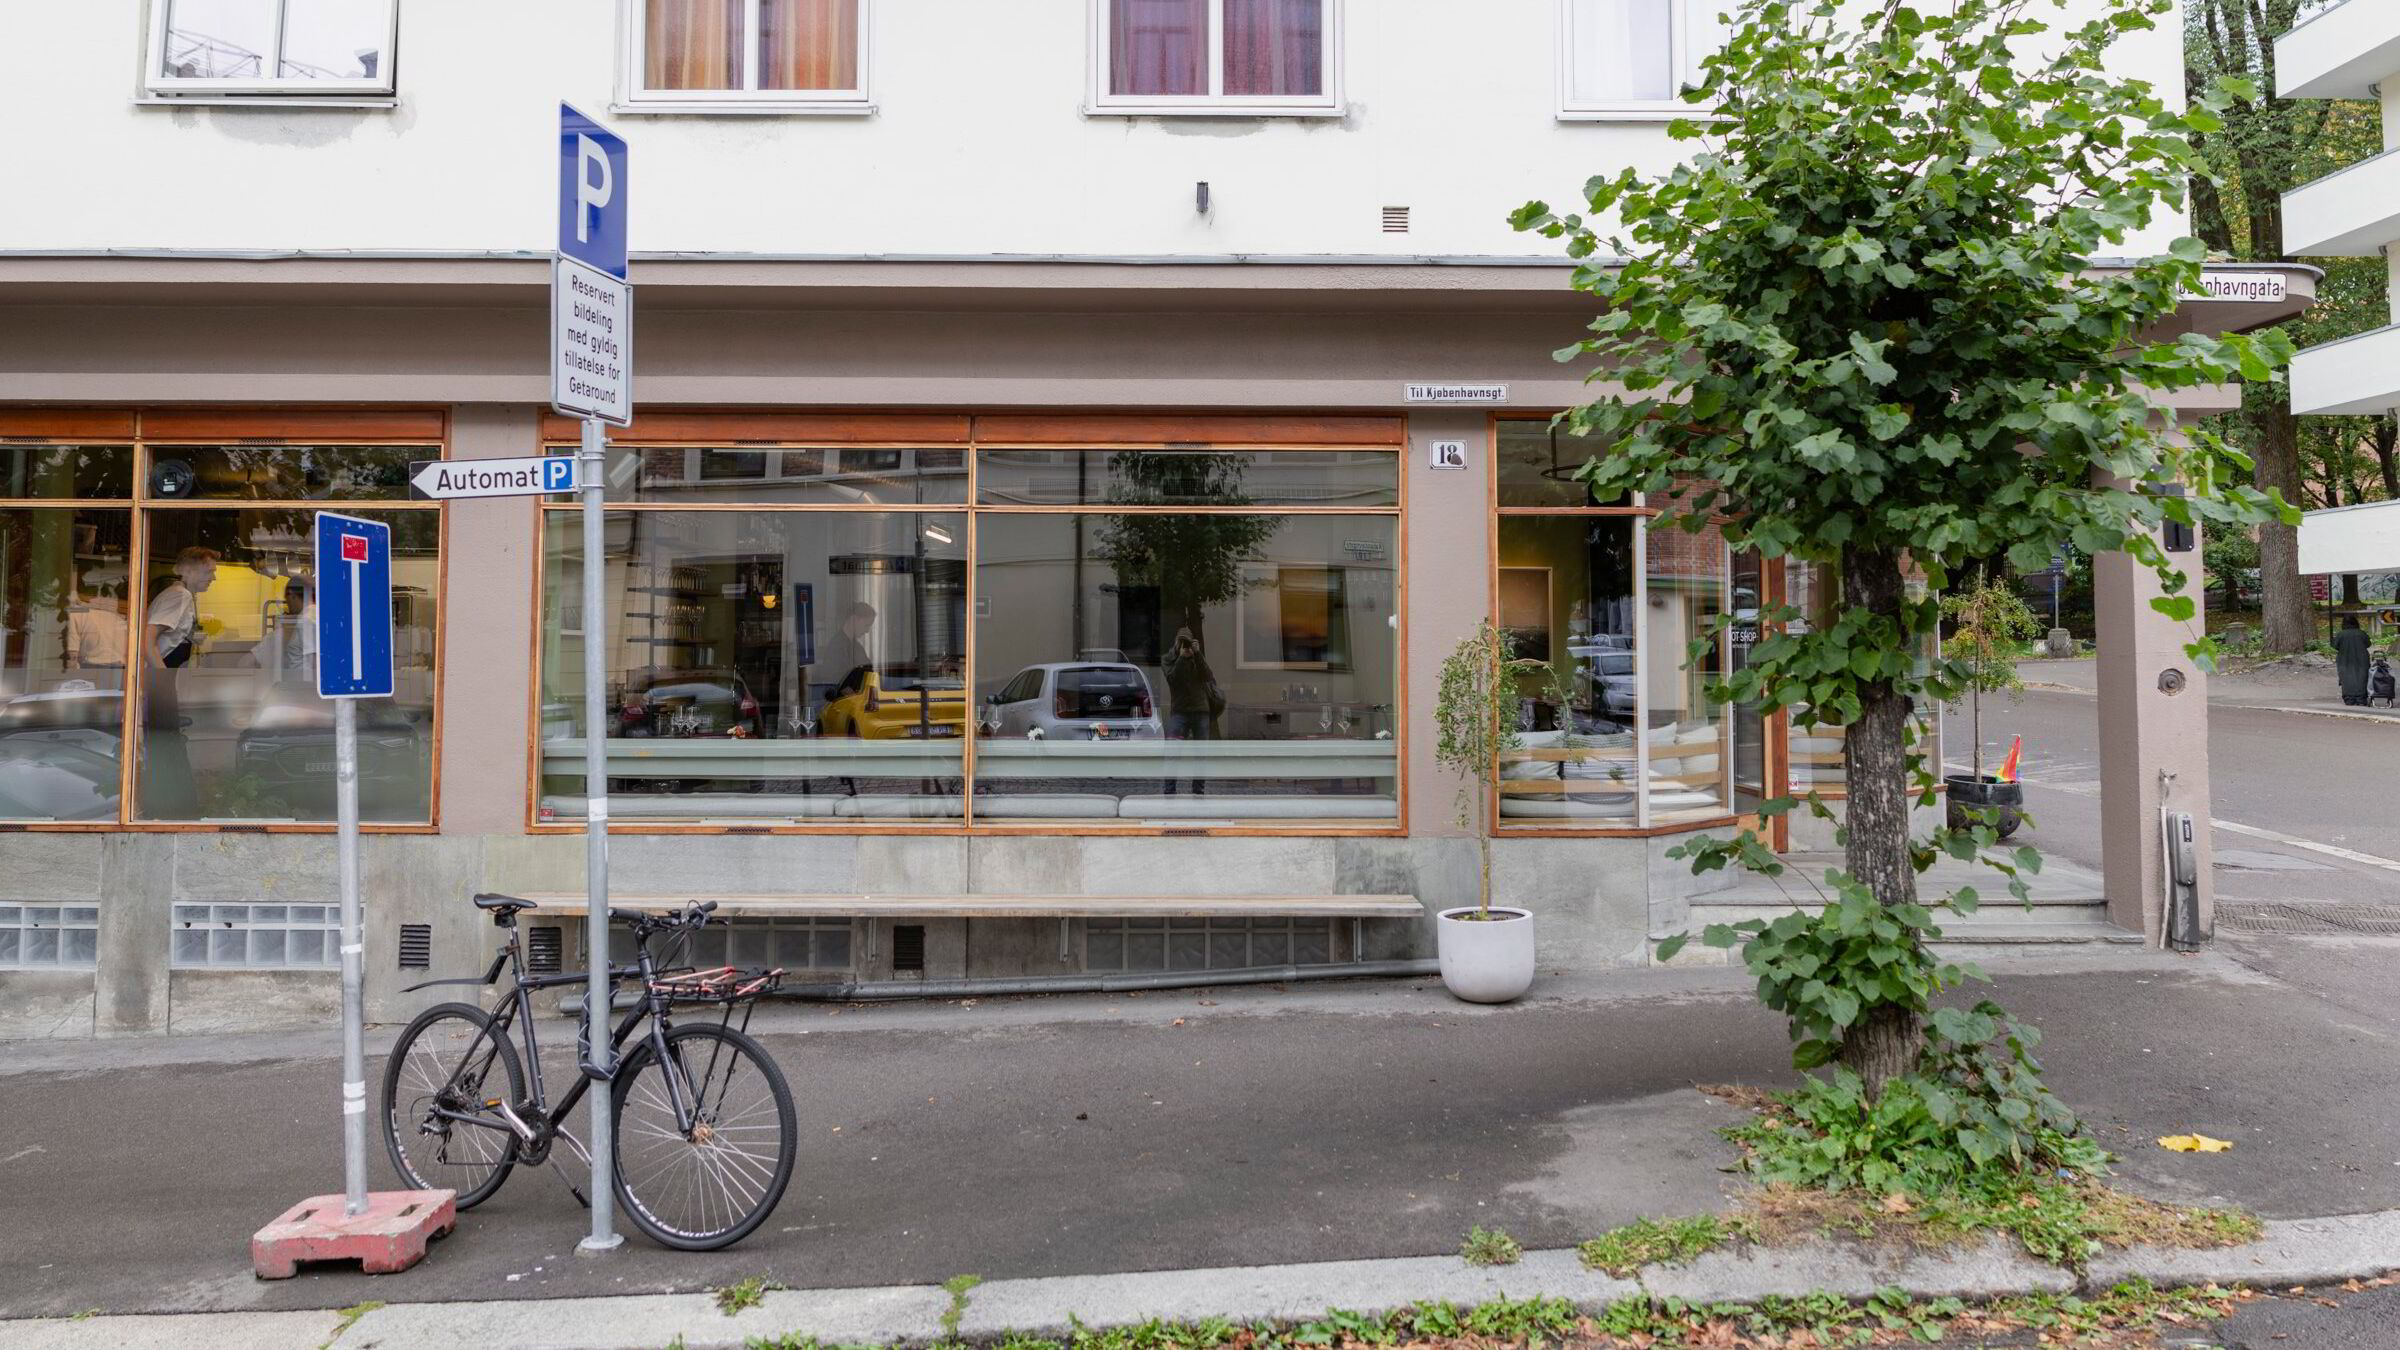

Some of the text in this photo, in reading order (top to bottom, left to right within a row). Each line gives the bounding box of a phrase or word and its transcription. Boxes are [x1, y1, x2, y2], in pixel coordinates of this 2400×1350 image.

[577, 132, 613, 244] P
[571, 274, 615, 307] Reservert
[573, 301, 613, 334] bildeling
[567, 327, 618, 360] med gyldig
[564, 349, 621, 381] tillatelse for
[569, 376, 616, 404] Getaround
[1410, 387, 1505, 400] Til Kjøbenhavnsgt.
[436, 461, 568, 491] Automat P
